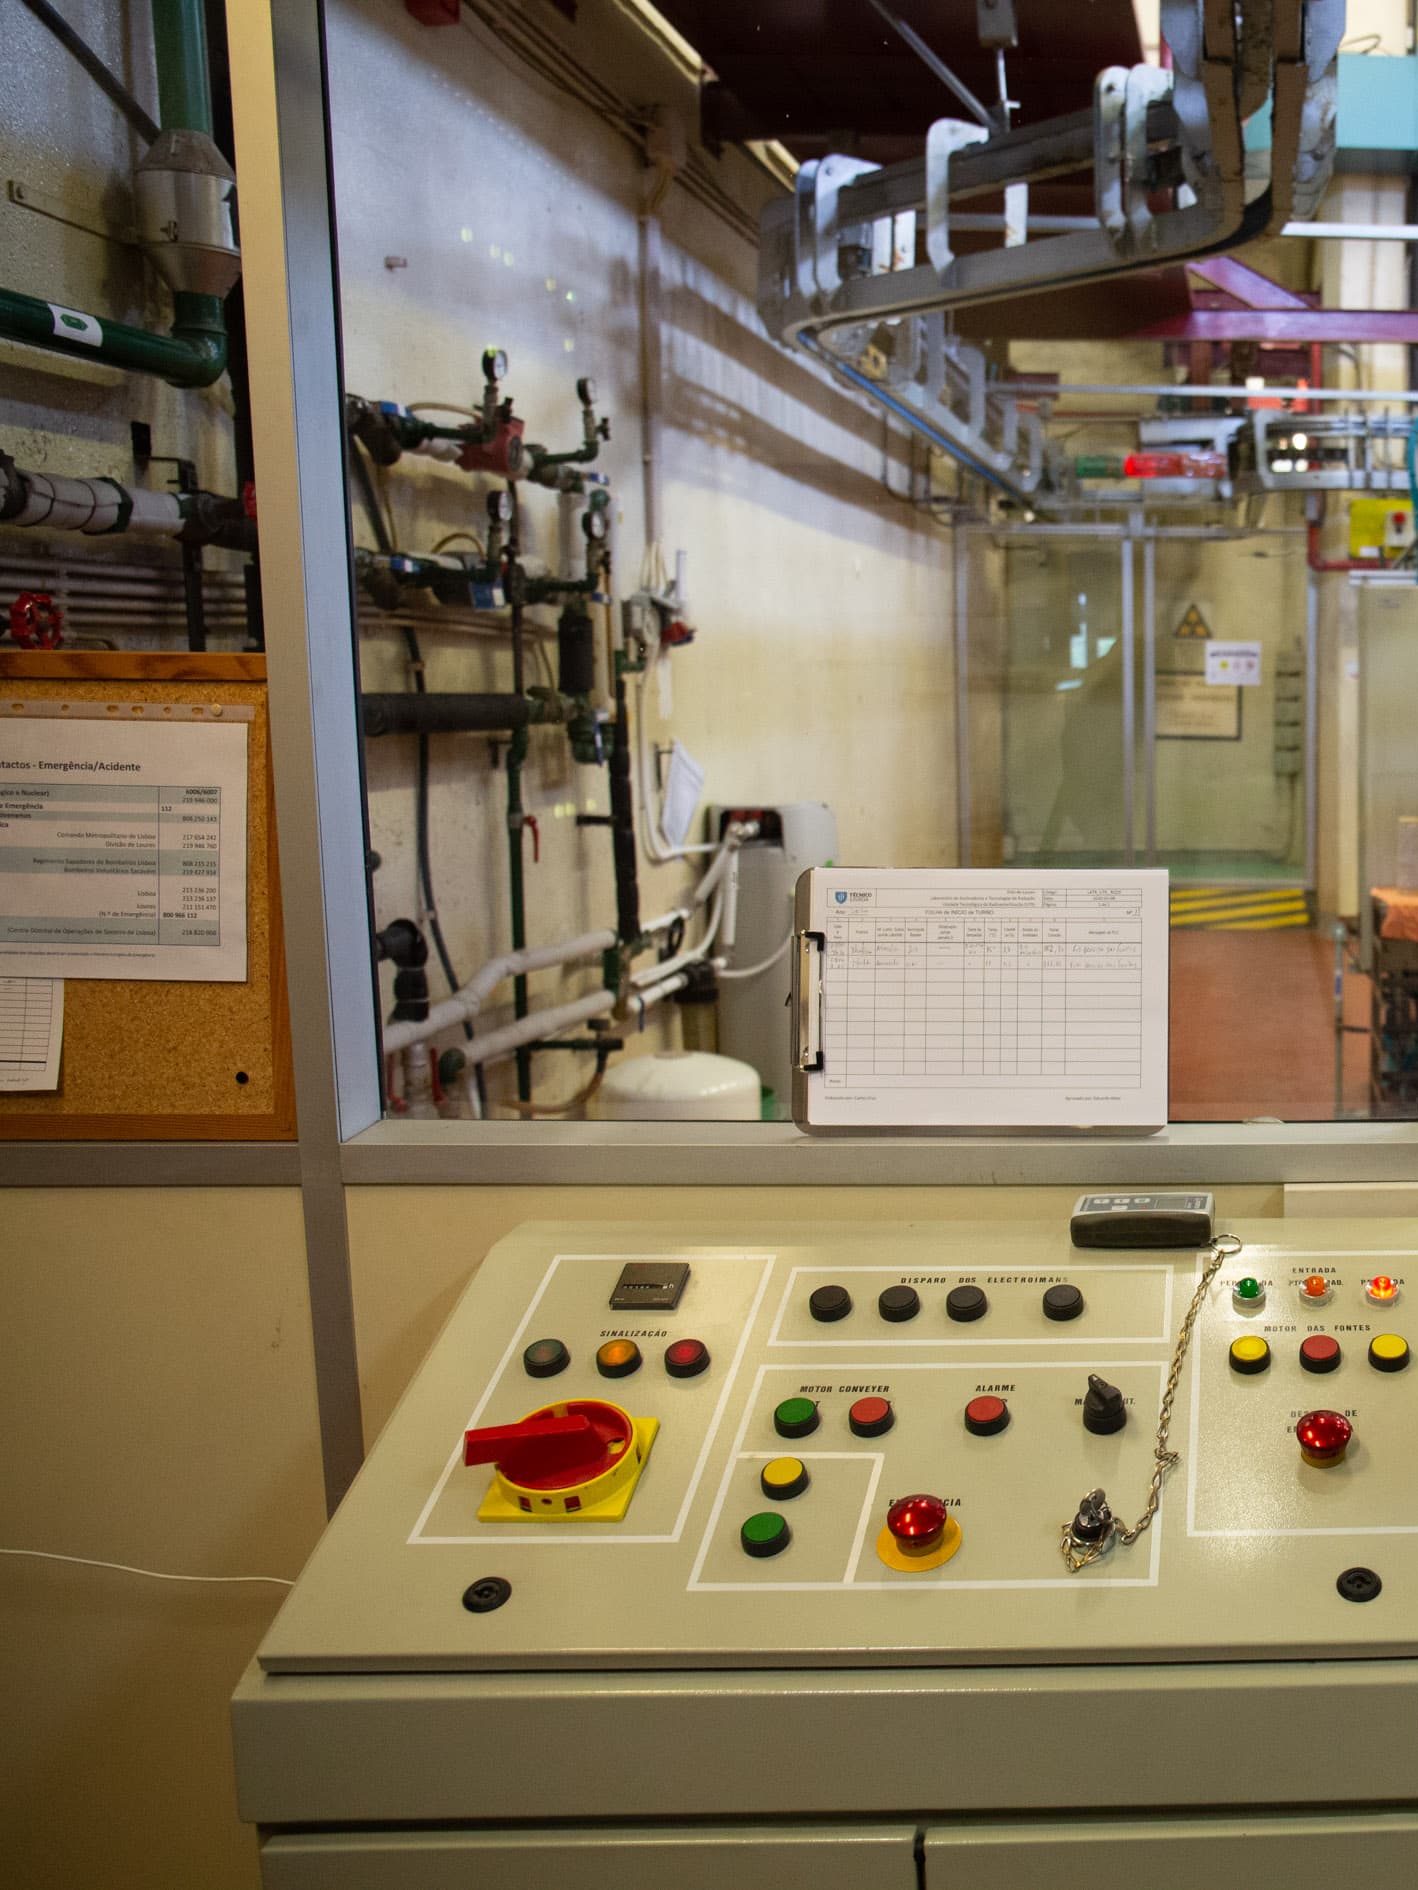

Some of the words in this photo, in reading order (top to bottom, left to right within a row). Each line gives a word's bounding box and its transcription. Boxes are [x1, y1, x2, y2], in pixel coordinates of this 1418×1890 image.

[38, 760, 141, 772] Emergência/Acidente
[1334, 1324, 1371, 1332] FONTES
[800, 1385, 833, 1393] MOTOR
[838, 1385, 890, 1393] CONVEYER
[975, 1384, 1016, 1392] ALARME
